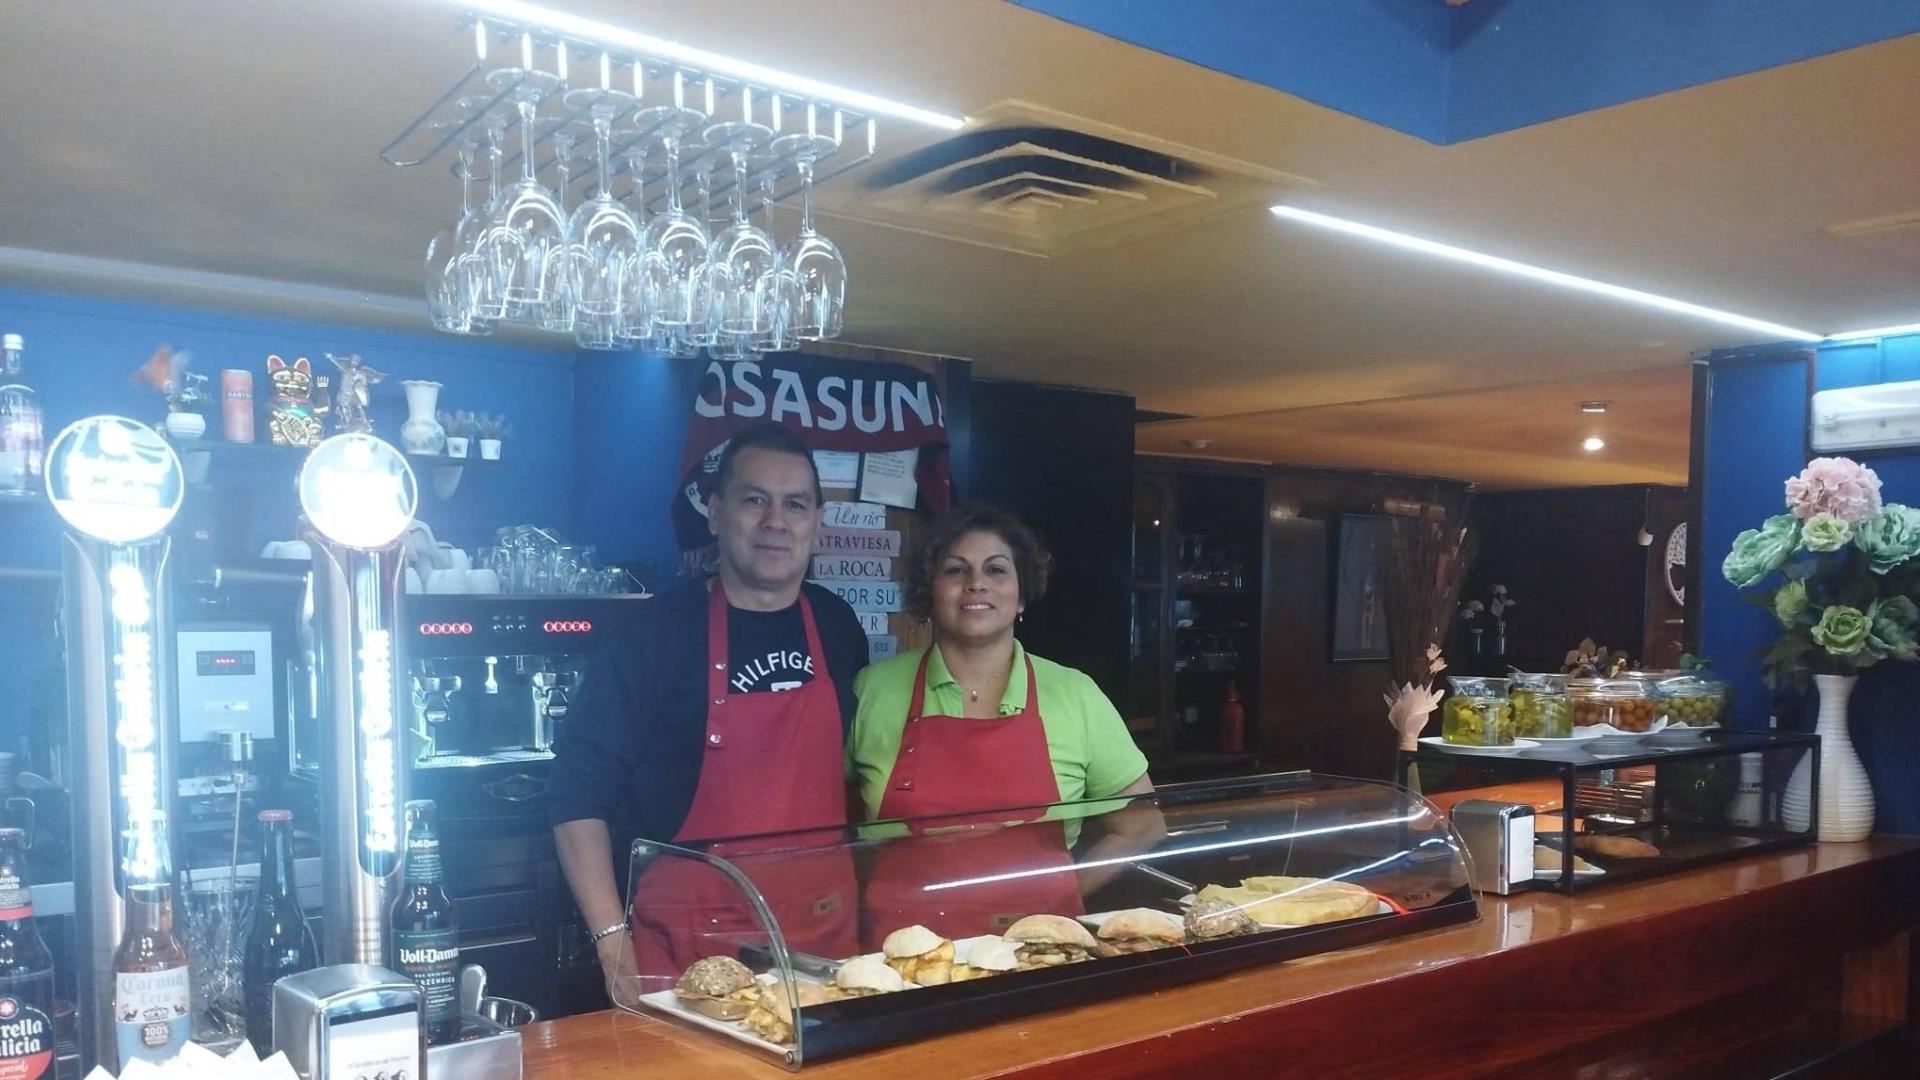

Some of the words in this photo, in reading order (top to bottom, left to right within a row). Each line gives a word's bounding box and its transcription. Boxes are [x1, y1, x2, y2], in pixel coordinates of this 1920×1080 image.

[695, 361, 944, 433] OSASUN
[820, 563, 834, 576] LA
[840, 560, 885, 577] ROCA
[837, 588, 868, 605] POR
[876, 589, 895, 605] SU
[400, 947, 459, 964] Voll-Damm
[122, 974, 183, 994] Corona
[0, 1018, 43, 1038] rella
[144, 1024, 169, 1037] 100%
[0, 1036, 41, 1057] licia
